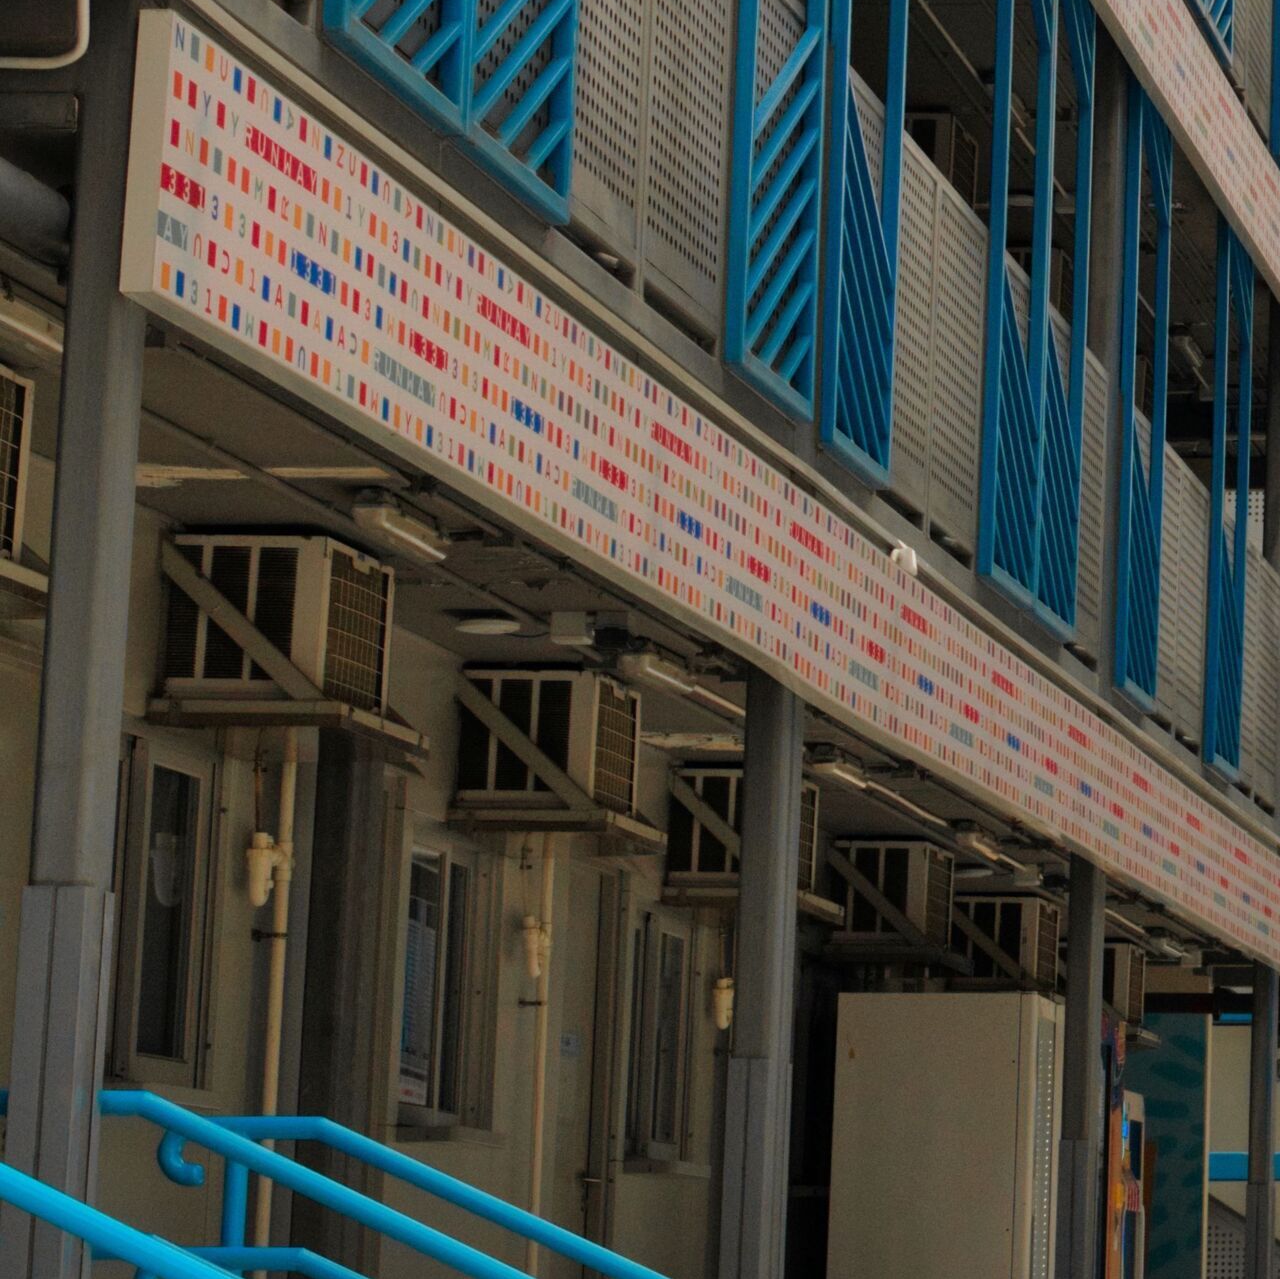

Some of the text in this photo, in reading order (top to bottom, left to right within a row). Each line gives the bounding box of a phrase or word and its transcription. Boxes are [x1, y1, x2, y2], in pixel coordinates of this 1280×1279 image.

[244, 122, 317, 197] RUNWAY
[477, 291, 531, 350] RUNWAY
[650, 418, 692, 466] RUNWAY
[290, 247, 336, 300] 1331
[408, 327, 448, 374] 1331
[511, 396, 544, 439] 1331
[598, 456, 628, 494] 1331
[372, 347, 435, 409] RUNWAY
[571, 475, 618, 524] RUNWAY
